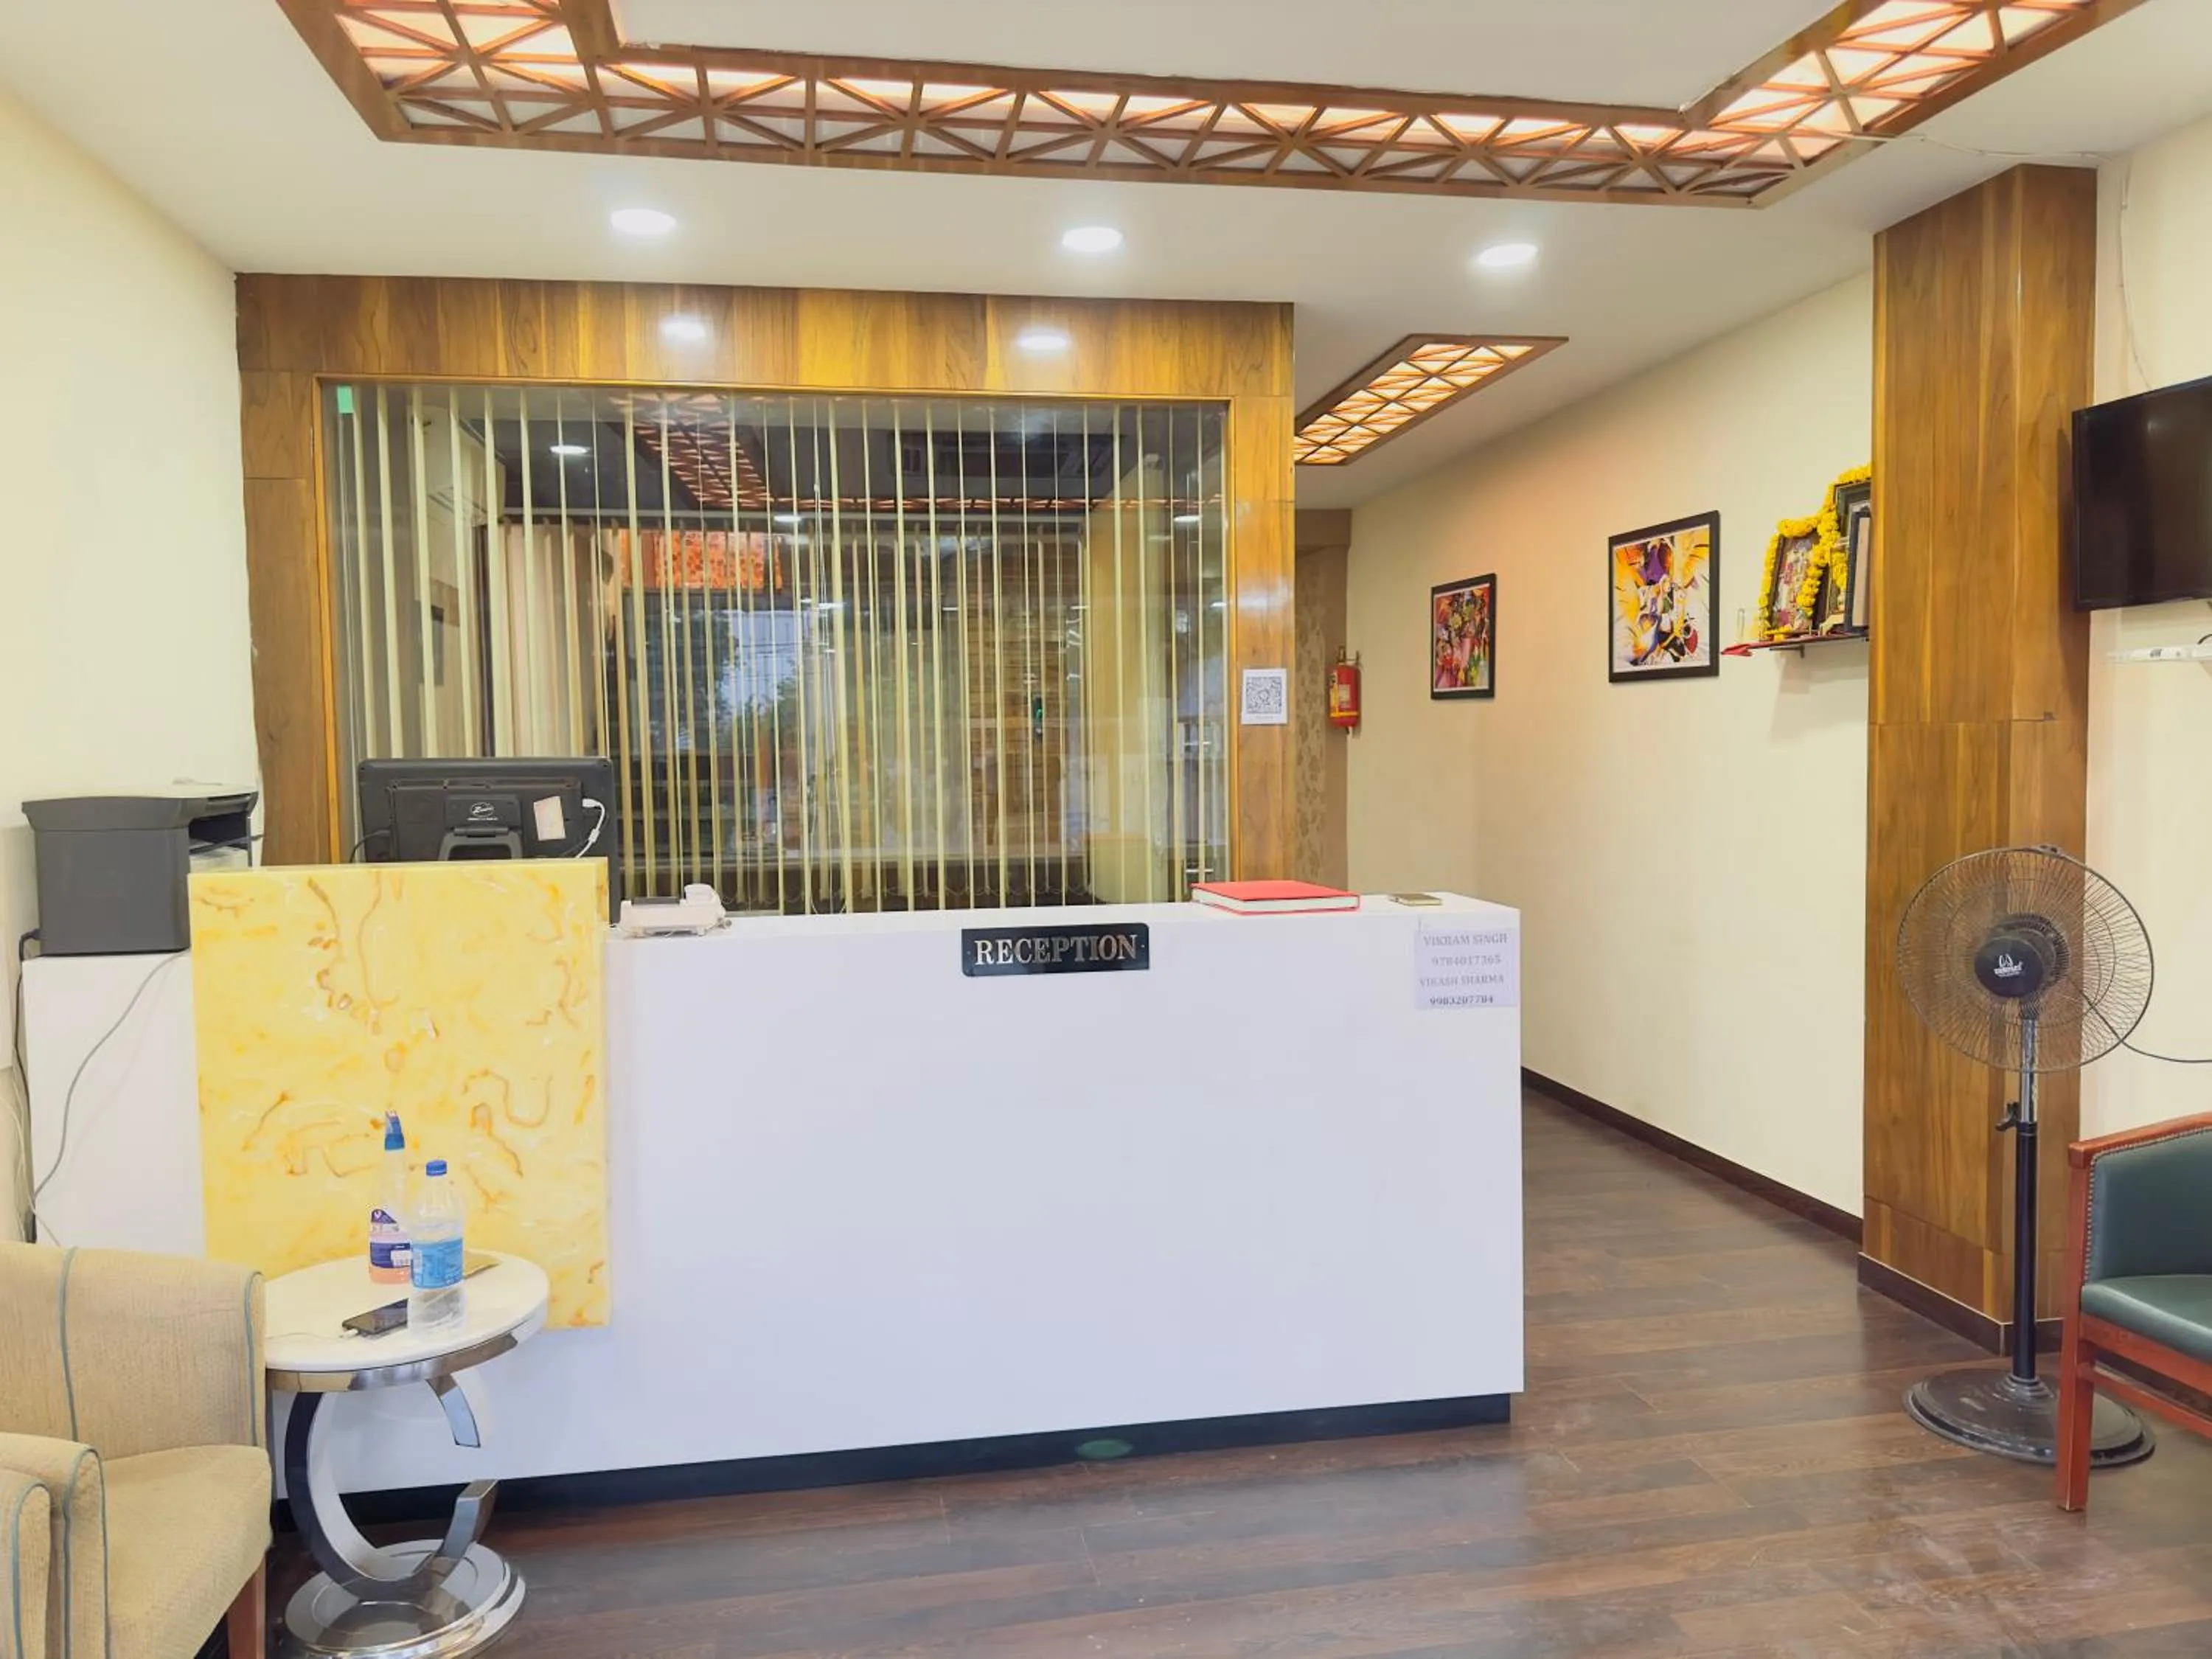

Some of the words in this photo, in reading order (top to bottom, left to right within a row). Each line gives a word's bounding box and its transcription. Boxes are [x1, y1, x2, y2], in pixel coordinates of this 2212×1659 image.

[1423, 934, 1470, 947] VIKRAM
[1472, 933, 1508, 945] SINGH
[974, 934, 1138, 966] RECEPTION
[1460, 974, 1505, 986] SHARMA
